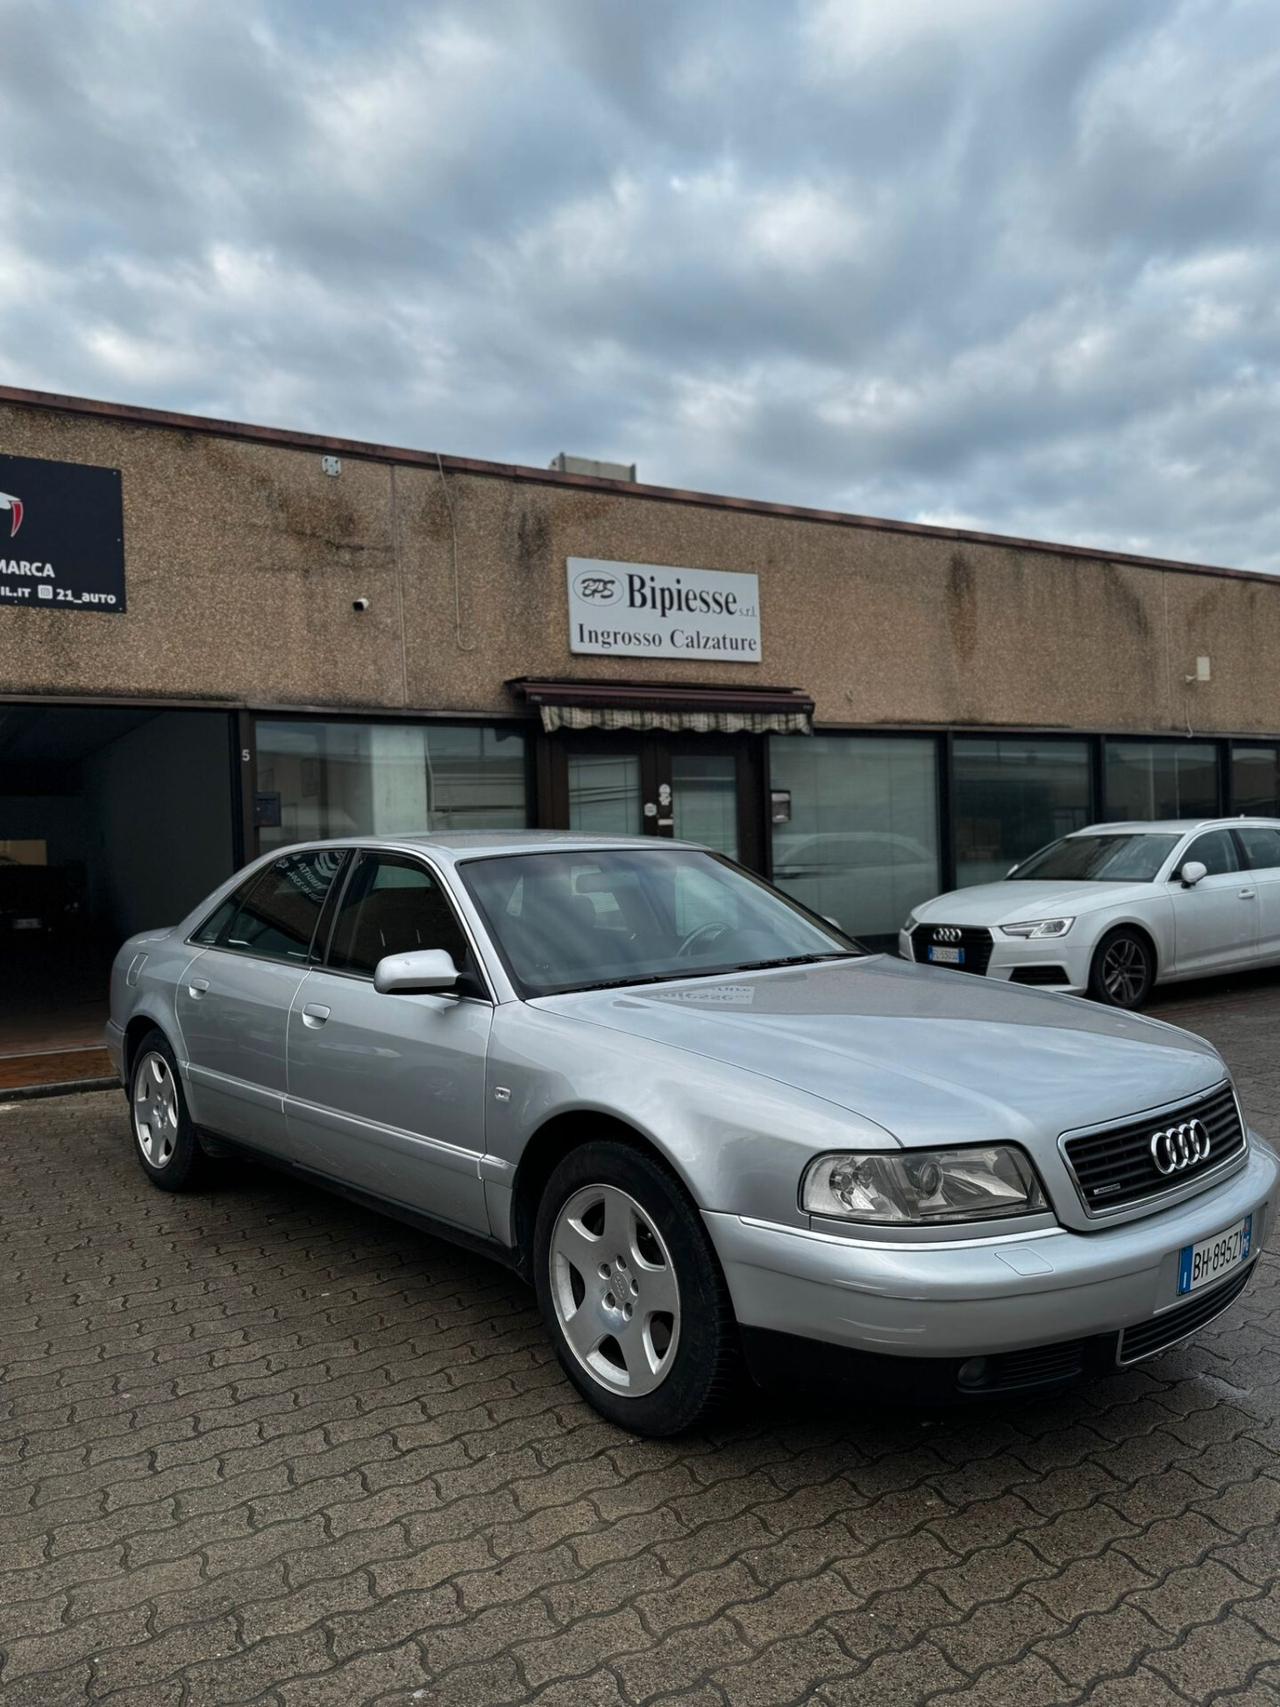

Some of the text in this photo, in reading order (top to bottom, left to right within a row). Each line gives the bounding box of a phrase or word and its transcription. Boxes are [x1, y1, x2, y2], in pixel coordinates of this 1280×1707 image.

[626, 573, 738, 618] Bipiesse
[577, 623, 757, 651] Ingrosso Calzature
[242, 749, 250, 761] 5
